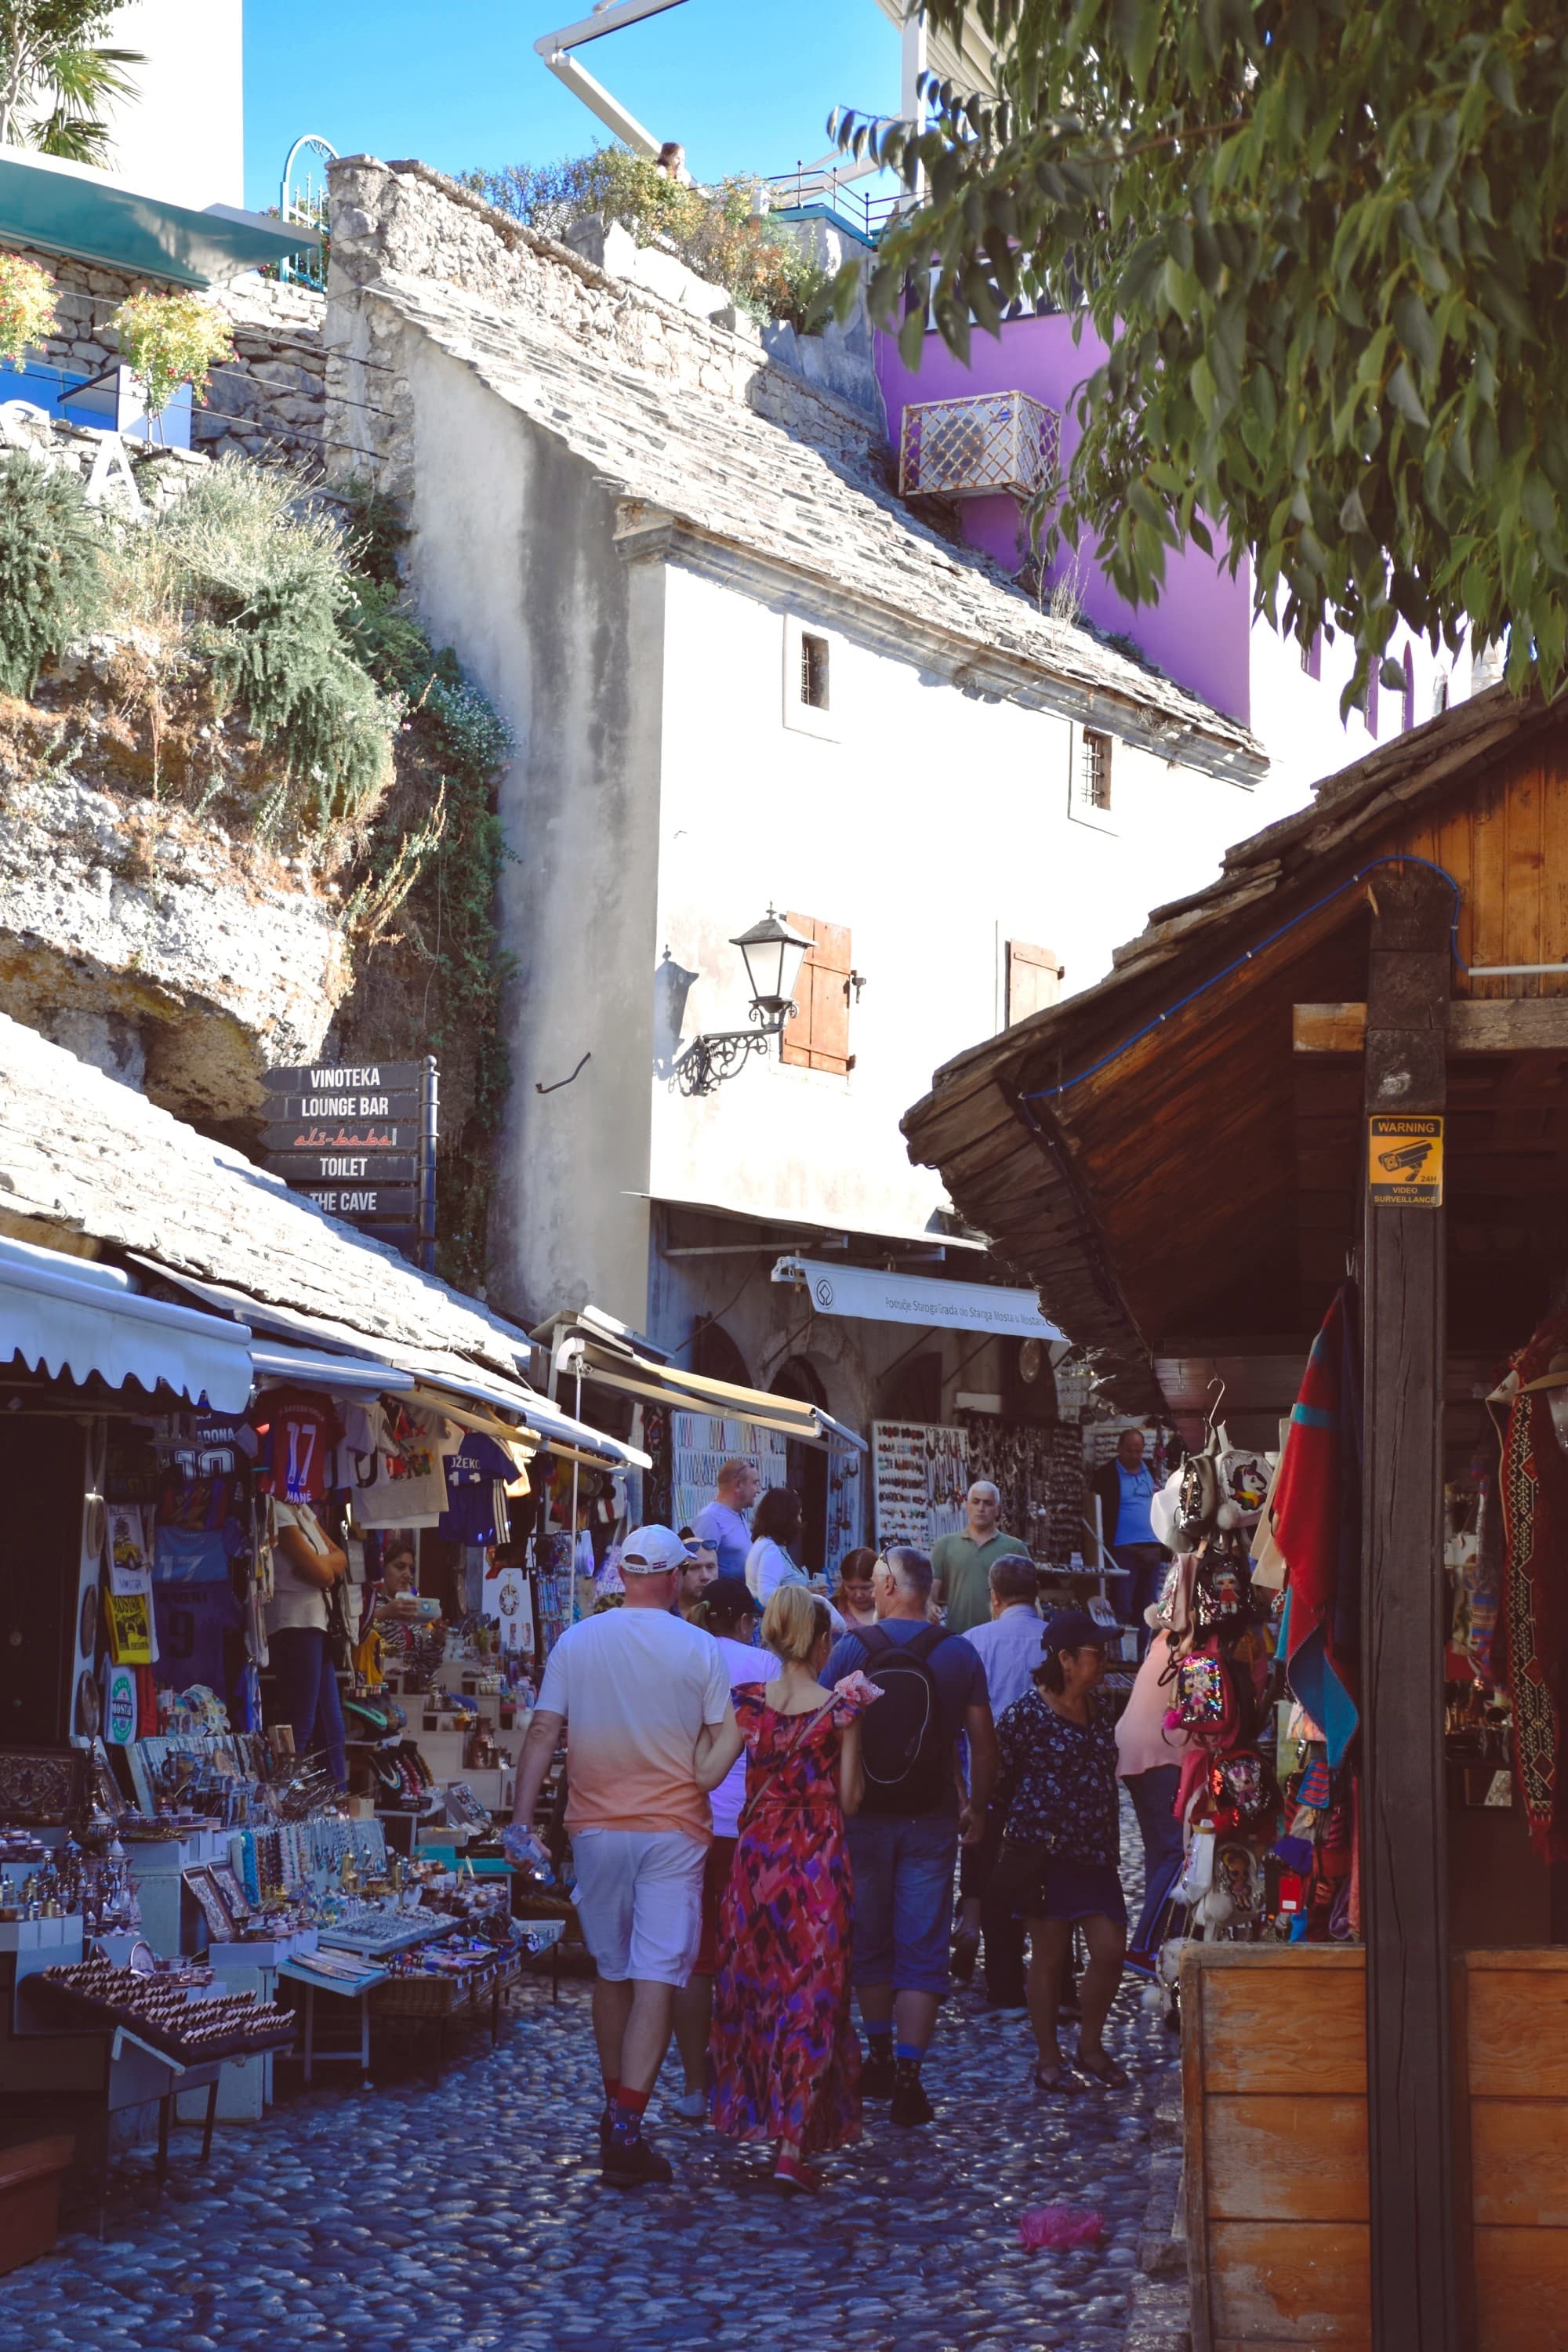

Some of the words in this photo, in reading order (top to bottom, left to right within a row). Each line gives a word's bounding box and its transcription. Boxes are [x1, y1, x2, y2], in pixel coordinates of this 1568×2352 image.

[310, 1068, 380, 1088] VINOTEKA
[302, 1098, 357, 1117] LOUNGE
[360, 1097, 389, 1115] BAR
[1378, 1122, 1436, 1133] WARNING
[320, 1158, 368, 1176] TOILET
[310, 1192, 336, 1211] THE
[340, 1192, 377, 1210] CAVE
[287, 1421, 317, 1486] 17
